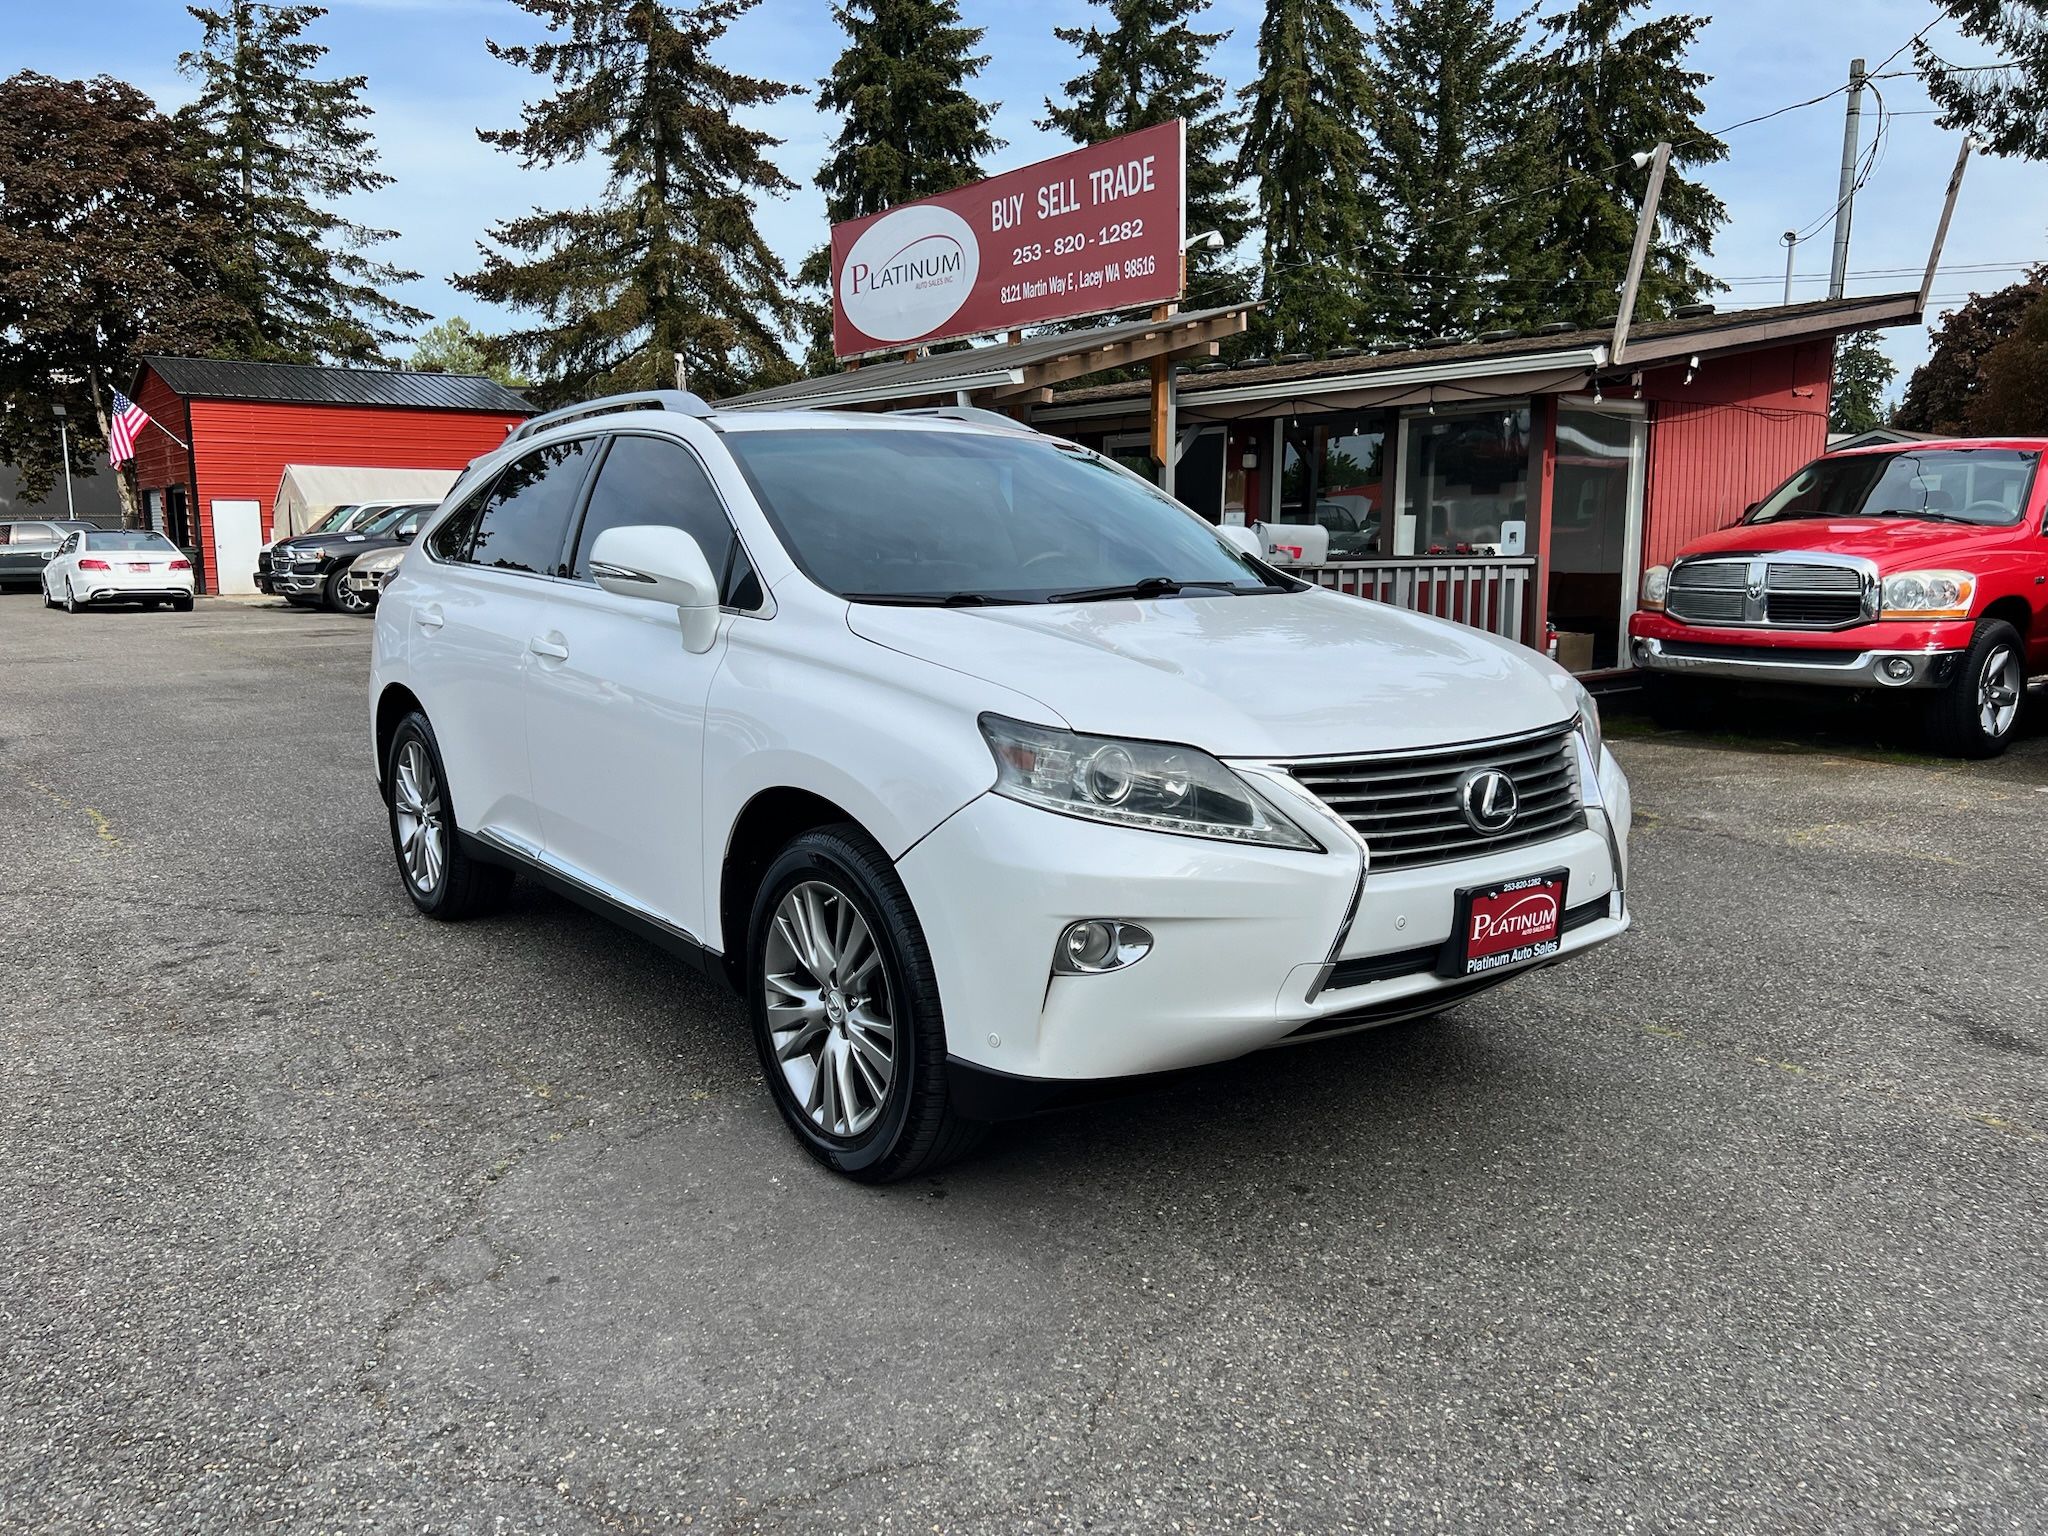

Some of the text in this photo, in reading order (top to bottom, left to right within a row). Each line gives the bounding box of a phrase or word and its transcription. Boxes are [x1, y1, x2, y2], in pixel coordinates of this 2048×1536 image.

[991, 155, 1155, 232] BUY SELL TRADE
[1012, 243, 1042, 266] 253
[1053, 232, 1086, 256] 820
[1098, 218, 1144, 246] 1282
[851, 251, 960, 295] PLATINUM
[915, 281, 928, 290] AUTO
[928, 277, 944, 288] SALES
[1000, 283, 1022, 304] 8121
[1022, 279, 1048, 299] Martin
[1049, 275, 1067, 296] Way
[1079, 270, 1104, 289] Lacey
[1104, 262, 1121, 283] WA
[1124, 255, 1155, 280] 98516
[1503, 877, 1542, 892] 253-820-1282
[1471, 908, 1555, 940] PLATINUM
[1521, 927, 1533, 936] AUTO
[1466, 940, 1558, 974] Platinum Auto Sales
